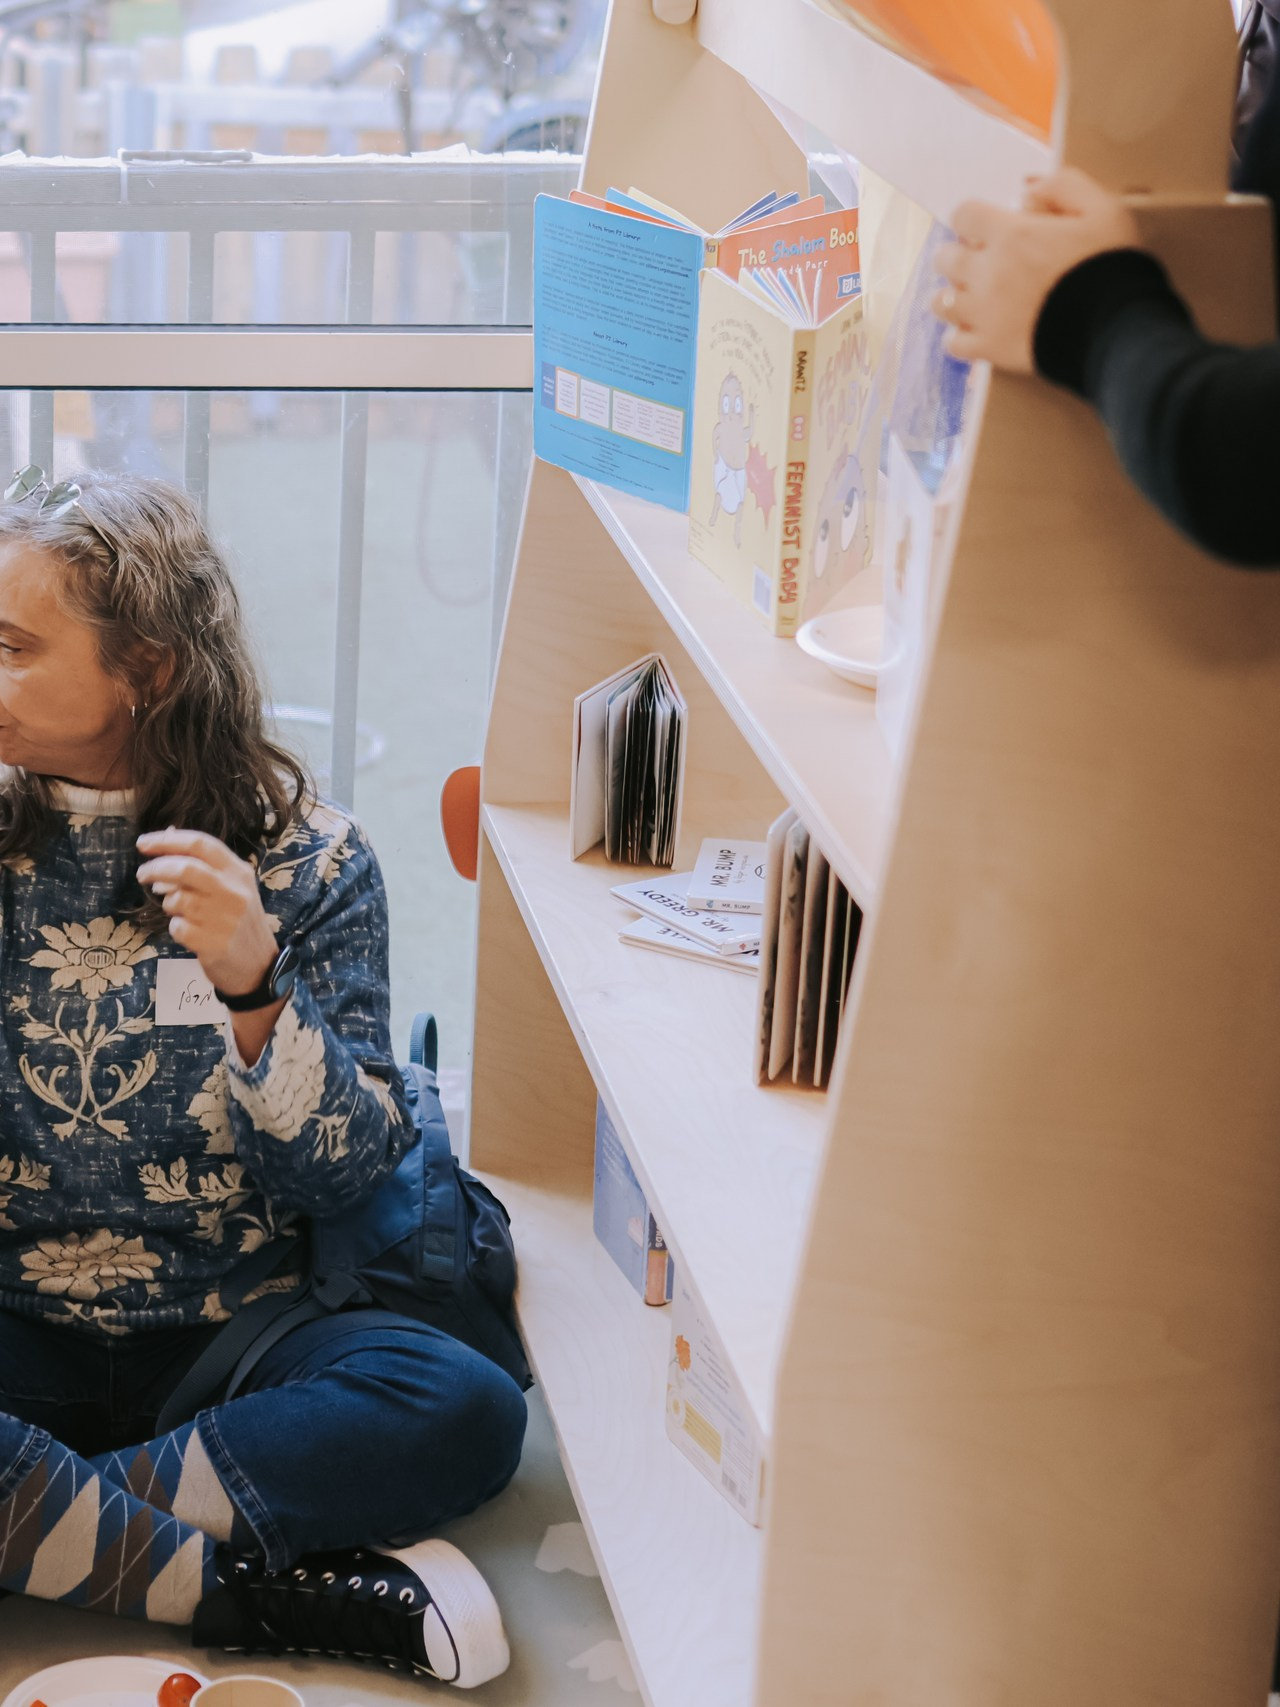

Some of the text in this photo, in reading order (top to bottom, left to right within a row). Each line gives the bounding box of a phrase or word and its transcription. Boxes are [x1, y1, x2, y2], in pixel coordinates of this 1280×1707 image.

[737, 247, 767, 267] The
[771, 236, 826, 262] Shalom
[805, 260, 828, 272] Parr
[782, 461, 806, 549] FEMINIST
[714, 849, 737, 871] BUMP
[636, 889, 700, 918] GREEDY
[701, 916, 735, 934] MR.
